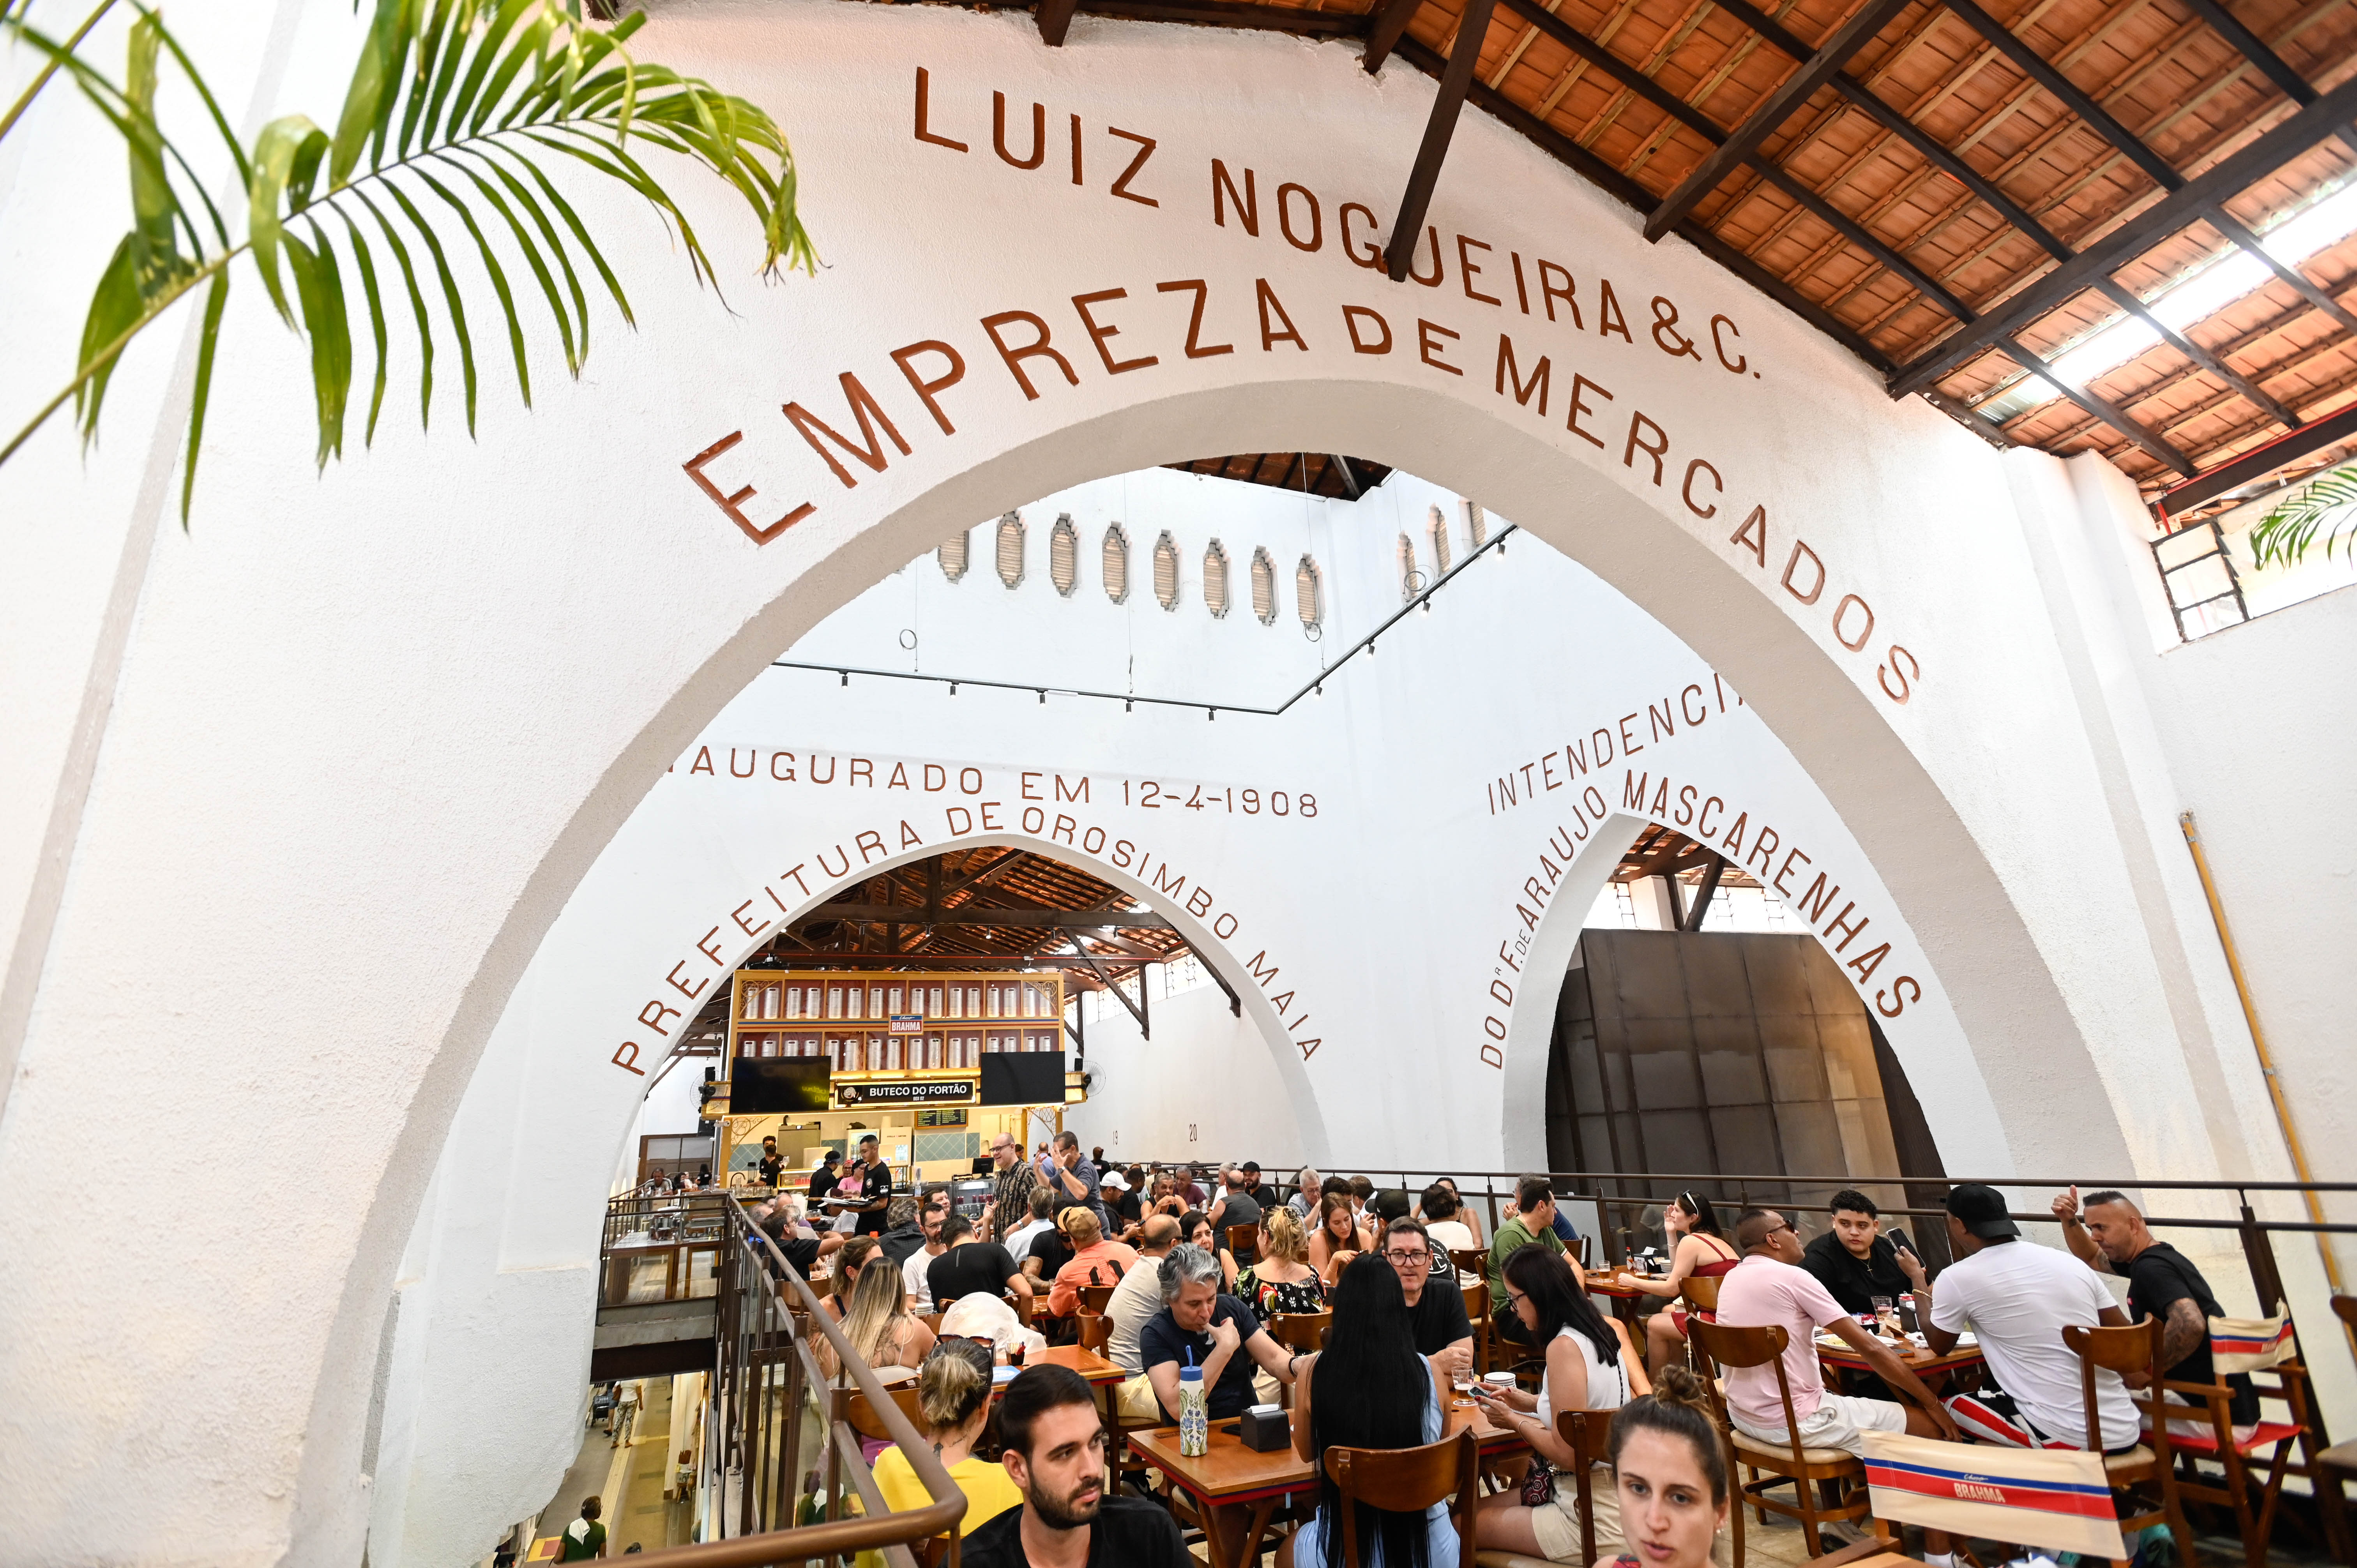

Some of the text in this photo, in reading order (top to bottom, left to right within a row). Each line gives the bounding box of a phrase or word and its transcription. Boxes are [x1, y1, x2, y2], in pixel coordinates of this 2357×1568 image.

[914, 65, 1161, 211] LUIZ
[683, 279, 1920, 705] EMPREZA DE MERCADOS
[1488, 673, 1743, 815] INTENDENCI
[668, 746, 1318, 818] AUGURADO EM 12-4-1908
[1516, 786, 1606, 932] ARAUJO
[1624, 769, 1921, 1018] MASCARENHAS
[611, 802, 1322, 1076] PREFEITURA DE OROSIMBO MAIA
[1515, 929, 1531, 956] DE
[891, 1022, 921, 1031] BRAHMA
[1481, 1016, 1506, 1070] DO
[869, 1084, 967, 1096] BUTECO DO FORTÃO
[1113, 1130, 1118, 1146] 19
[1189, 1124, 1197, 1142] 20
[1954, 1482, 2005, 1503] BRAHMA
